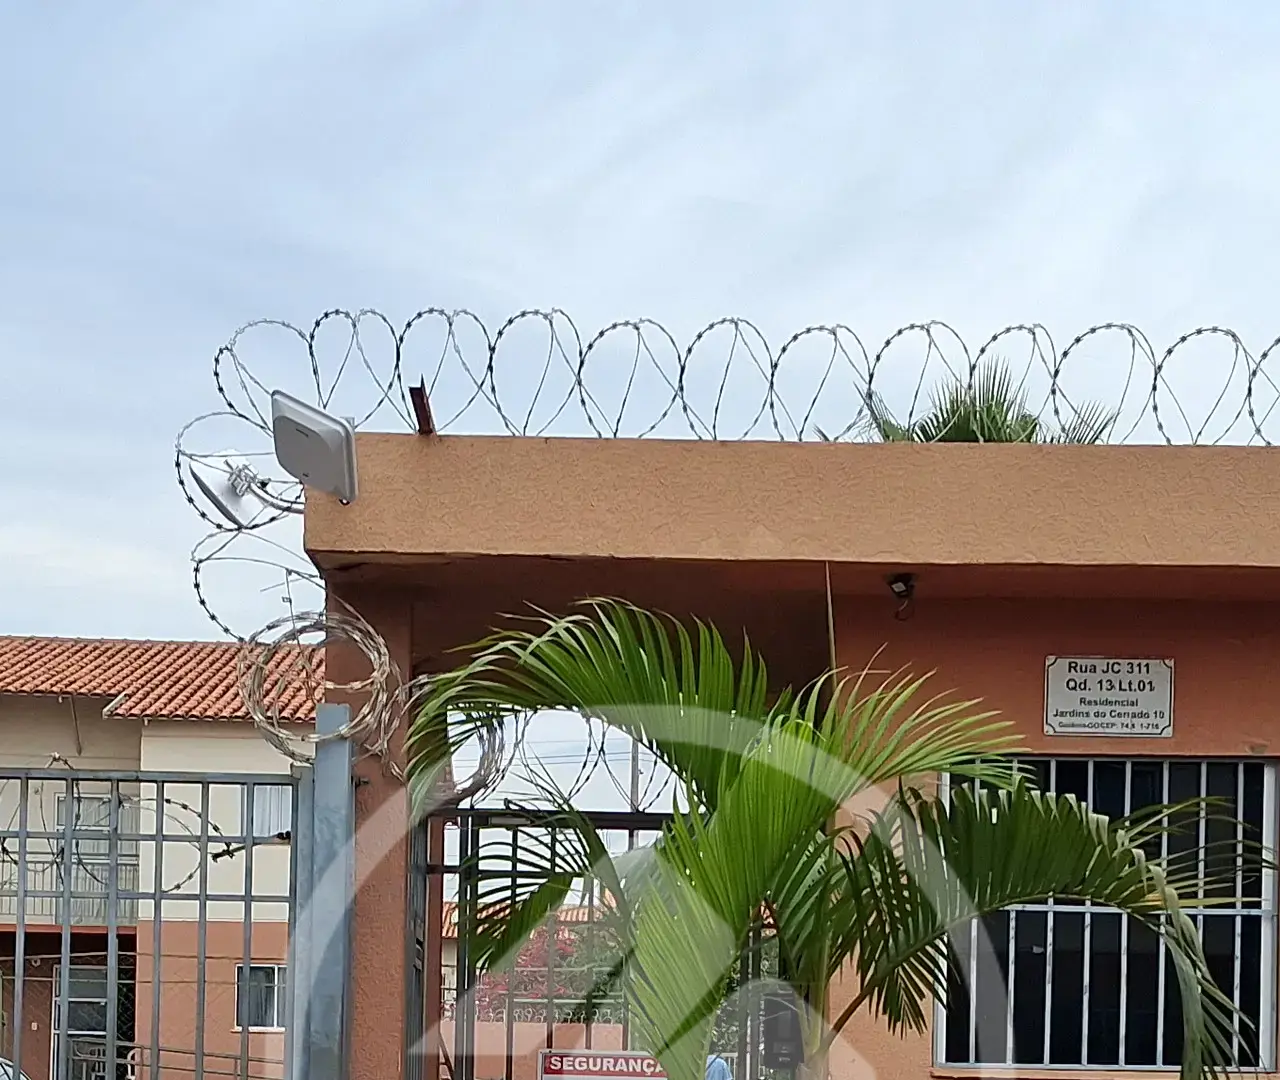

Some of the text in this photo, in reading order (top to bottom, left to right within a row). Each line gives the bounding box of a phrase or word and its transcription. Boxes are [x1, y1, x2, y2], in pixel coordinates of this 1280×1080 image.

[1068, 661, 1150, 675] Rua JC 311
[1065, 678, 1092, 692] Qd.
[1079, 697, 1139, 707] Residencial
[1053, 709, 1090, 718] Jardins
[1093, 710, 1107, 718] do
